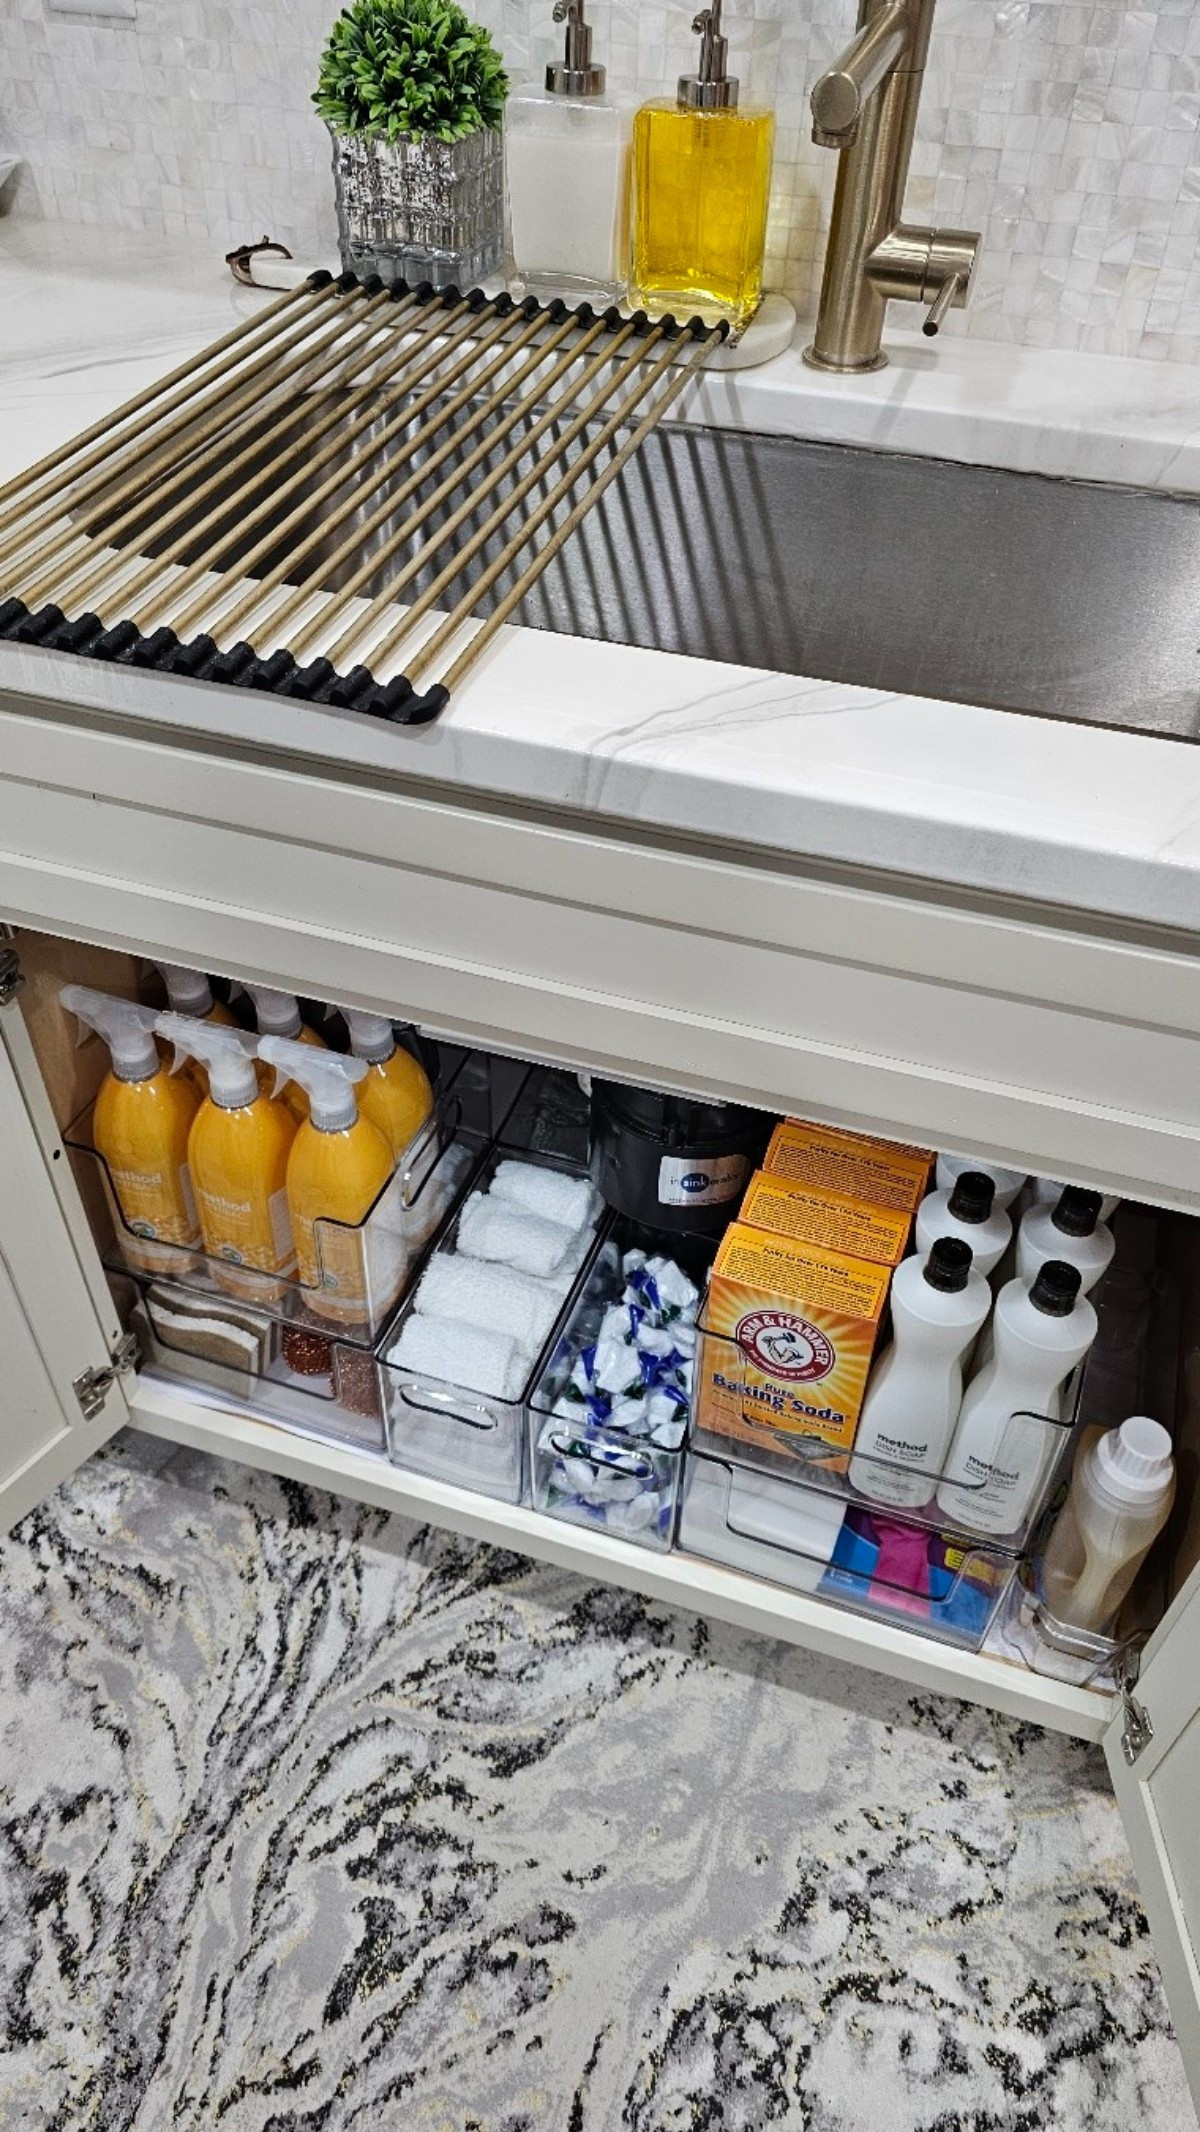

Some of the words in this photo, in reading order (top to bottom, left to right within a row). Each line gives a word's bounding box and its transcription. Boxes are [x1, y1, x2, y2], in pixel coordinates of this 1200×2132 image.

[741, 1318, 764, 1344] ARM
[762, 1315, 777, 1326] &
[778, 1316, 830, 1366] HAMMER
[712, 1372, 786, 1410] Baking
[792, 1399, 845, 1424] Soda
[764, 1382, 795, 1399] Pure
[877, 1433, 928, 1452] method
[968, 1455, 1020, 1480] method
